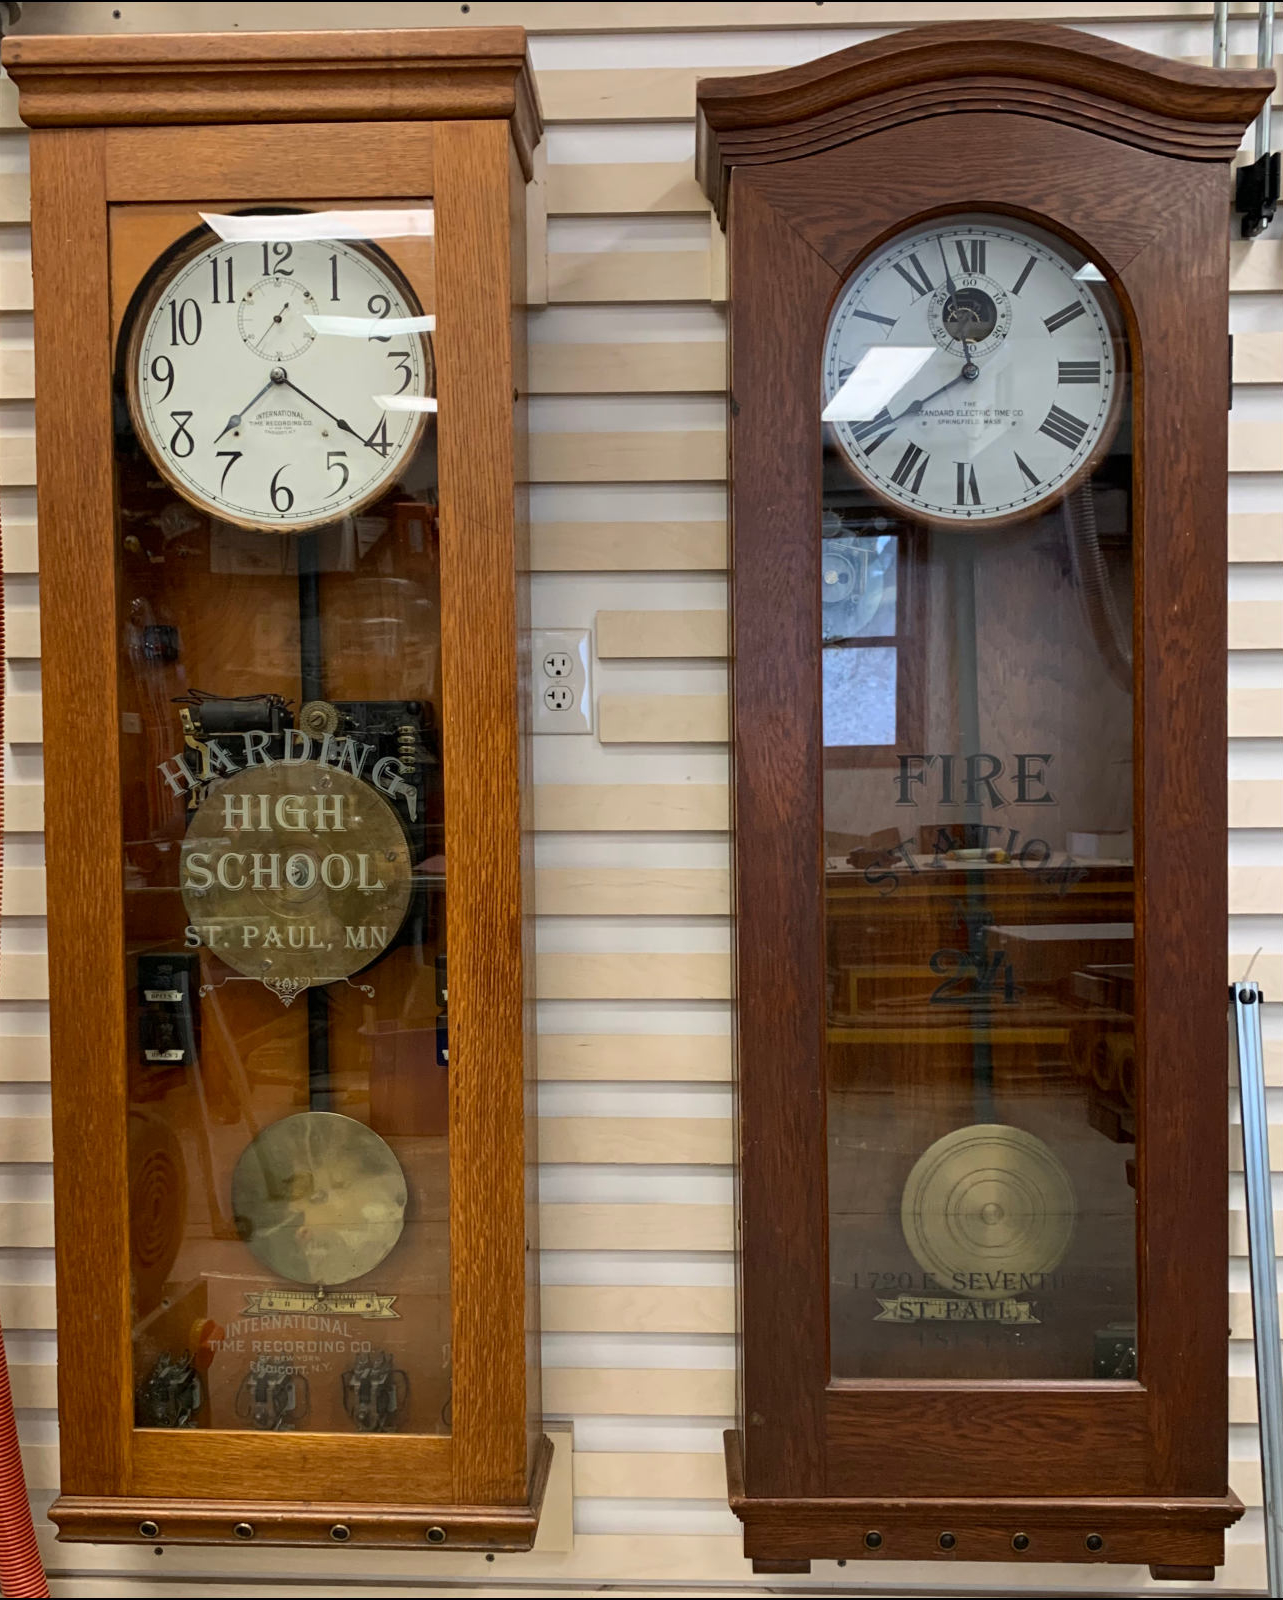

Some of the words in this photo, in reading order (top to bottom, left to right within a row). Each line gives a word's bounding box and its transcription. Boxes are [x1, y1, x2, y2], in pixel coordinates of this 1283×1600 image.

[262, 241, 294, 276] 12
[328, 254, 341, 301] 1
[955, 239, 991, 275] XII
[210, 256, 236, 304] 11
[962, 279, 977, 287] 60
[993, 292, 1003, 305] 10
[169, 298, 201, 346] 10
[366, 294, 392, 343] 2
[992, 325, 1003, 338] 20
[151, 355, 175, 405] 9
[387, 351, 413, 396] 3
[169, 411, 195, 458] 8
[256, 410, 304, 420] INTERNATIONAL
[364, 410, 394, 456] 4
[917, 409, 954, 417] STANDARD
[956, 409, 991, 417] ELECTRIC
[994, 409, 1010, 417] TIME
[215, 451, 243, 498] 7
[270, 463, 294, 513] 6
[324, 451, 350, 499] 5
[953, 462, 985, 506] VI
[1014, 450, 1049, 493] V
[157, 728, 406, 799] HARDING
[893, 753, 1058, 810] FIRE
[222, 793, 348, 832] HIGH
[184, 852, 386, 891] SCHOOL
[864, 822, 1089, 897] STATION
[183, 925, 231, 949] ST.
[241, 925, 333, 951] PAUL,
[345, 925, 389, 950] MN
[225, 1314, 353, 1338] INTERNATIONAL
[899, 1301, 936, 1320] ST.
[207, 1340, 246, 1352] TIME
[252, 1340, 346, 1353] RECORDING
[350, 1340, 376, 1353] CO.
